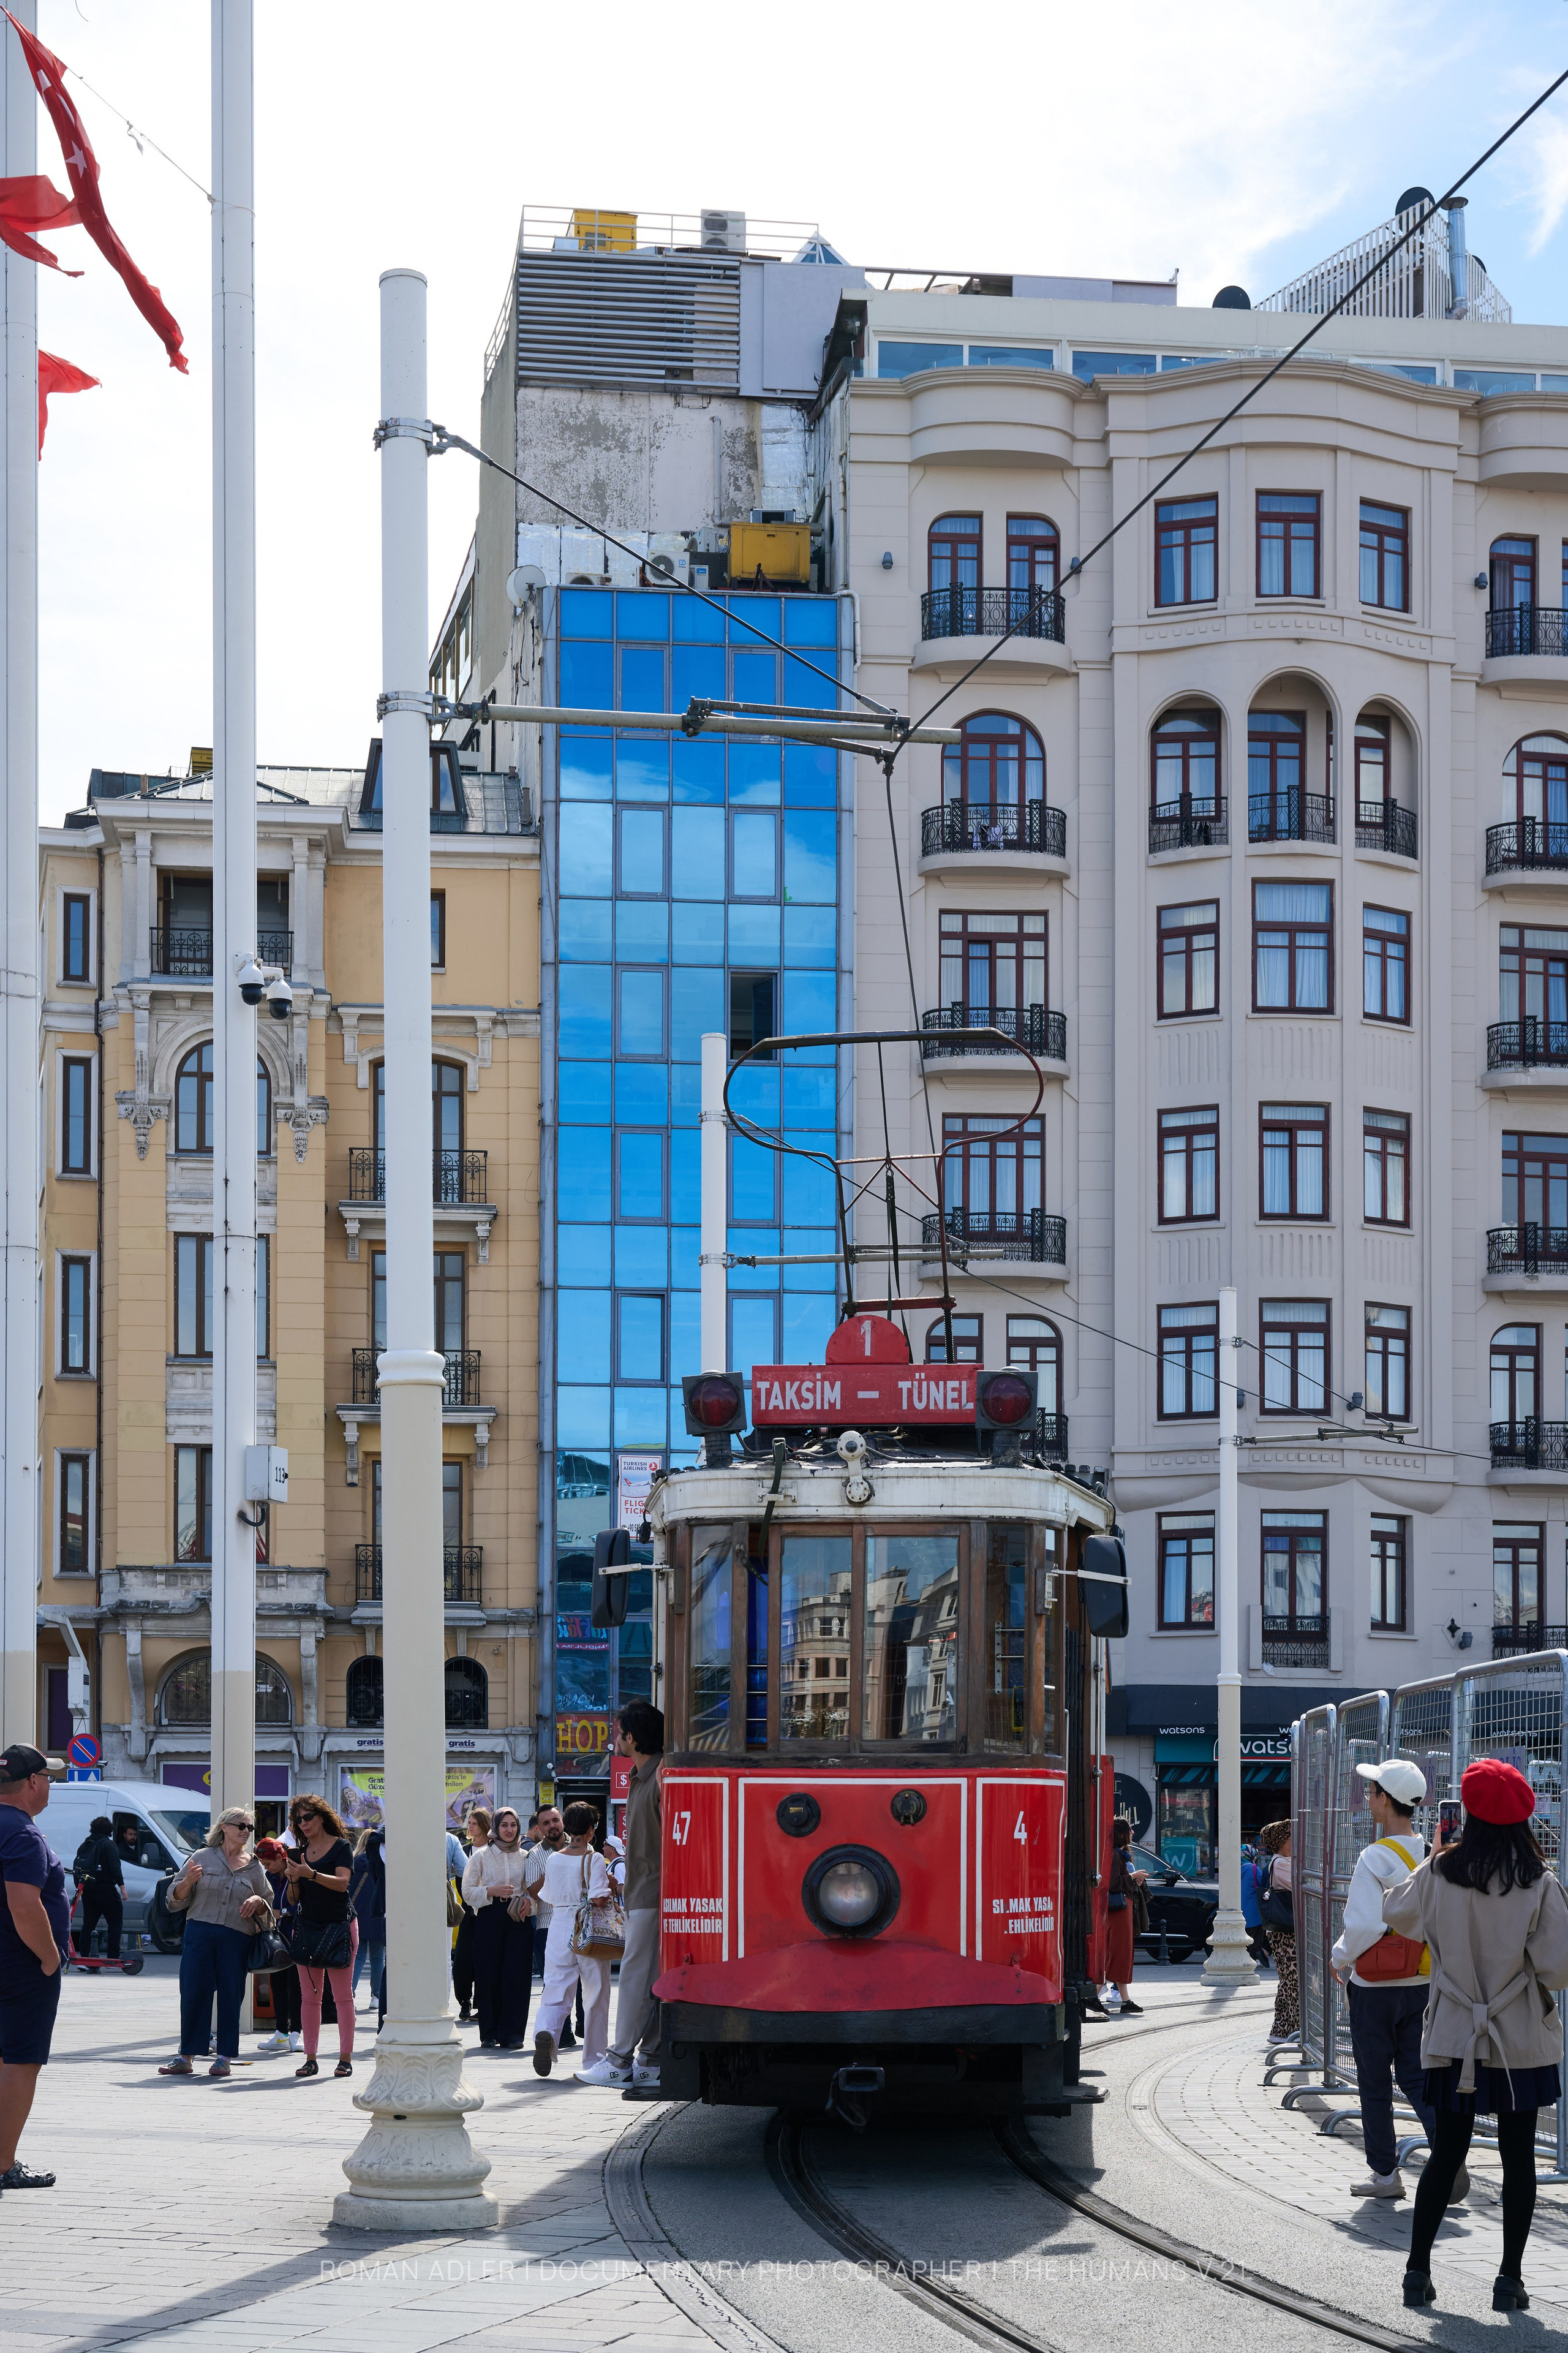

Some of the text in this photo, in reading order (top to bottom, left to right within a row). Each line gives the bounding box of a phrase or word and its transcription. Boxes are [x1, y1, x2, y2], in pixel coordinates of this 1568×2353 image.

[861, 1320, 871, 1356] 1
[756, 1373, 841, 1410] TAKSİM
[898, 1372, 974, 1410] TÜNEL
[275, 1466, 285, 1484] 113
[673, 1811, 691, 1845] 47
[690, 1898, 723, 1913] YASAK
[992, 1898, 1031, 1914] SIMAK
[669, 1916, 723, 1933] TEHLİKELİDİR
[1004, 1914, 1054, 1934] EHLİKELİDİR
